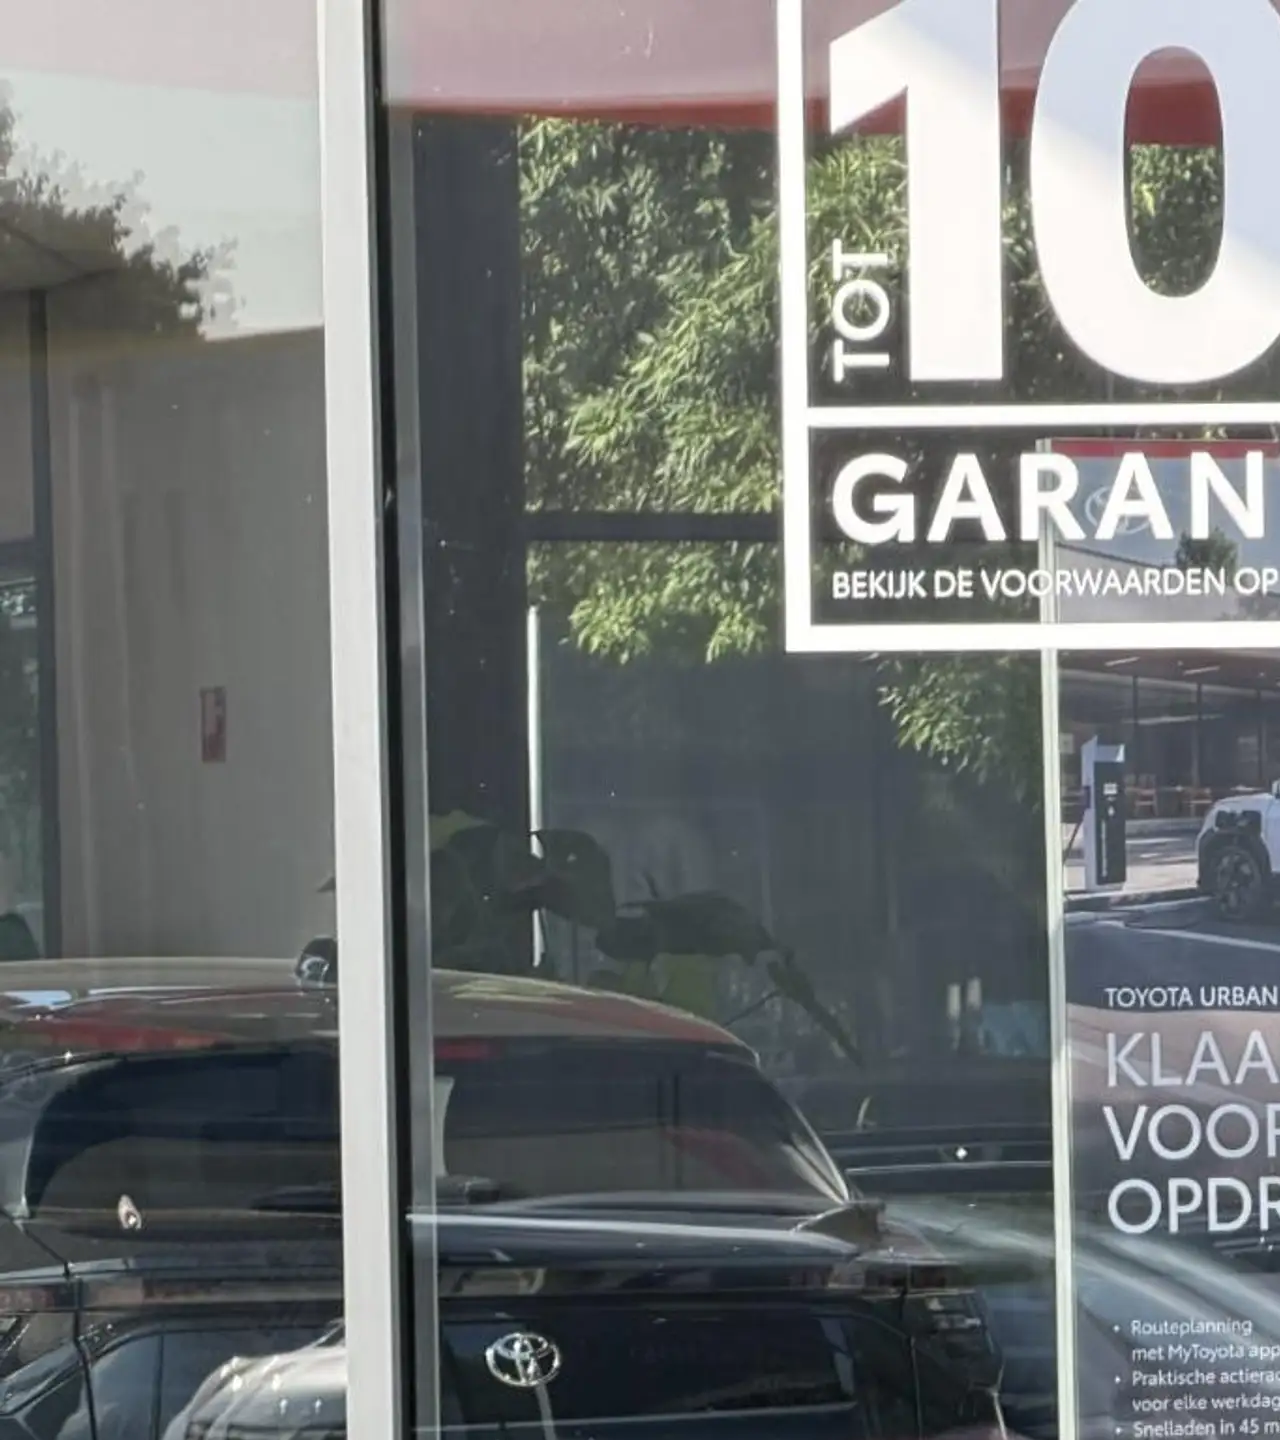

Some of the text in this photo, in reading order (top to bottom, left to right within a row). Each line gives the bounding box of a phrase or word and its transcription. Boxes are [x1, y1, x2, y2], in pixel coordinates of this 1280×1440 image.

[831, 238, 891, 381] TOT
[831, 570, 928, 600] BEKIJK
[934, 570, 973, 598] DE
[980, 568, 1225, 598] VOORWAARDEN
[1234, 567, 1280, 597] OP
[1104, 986, 1193, 1008] TOYOTA
[1200, 985, 1278, 1007] URBAN
[1131, 1317, 1253, 1338] Routeplanning
[1131, 1344, 1163, 1362] met
[1167, 1341, 1244, 1363] MyToyota
[1132, 1368, 1215, 1387] Praktische
[1131, 1396, 1171, 1412] voor
[1174, 1393, 1208, 1411] elke
[1133, 1418, 1215, 1437] Snelladen
[1219, 1417, 1236, 1435] in
[1239, 1417, 1260, 1435] 45
